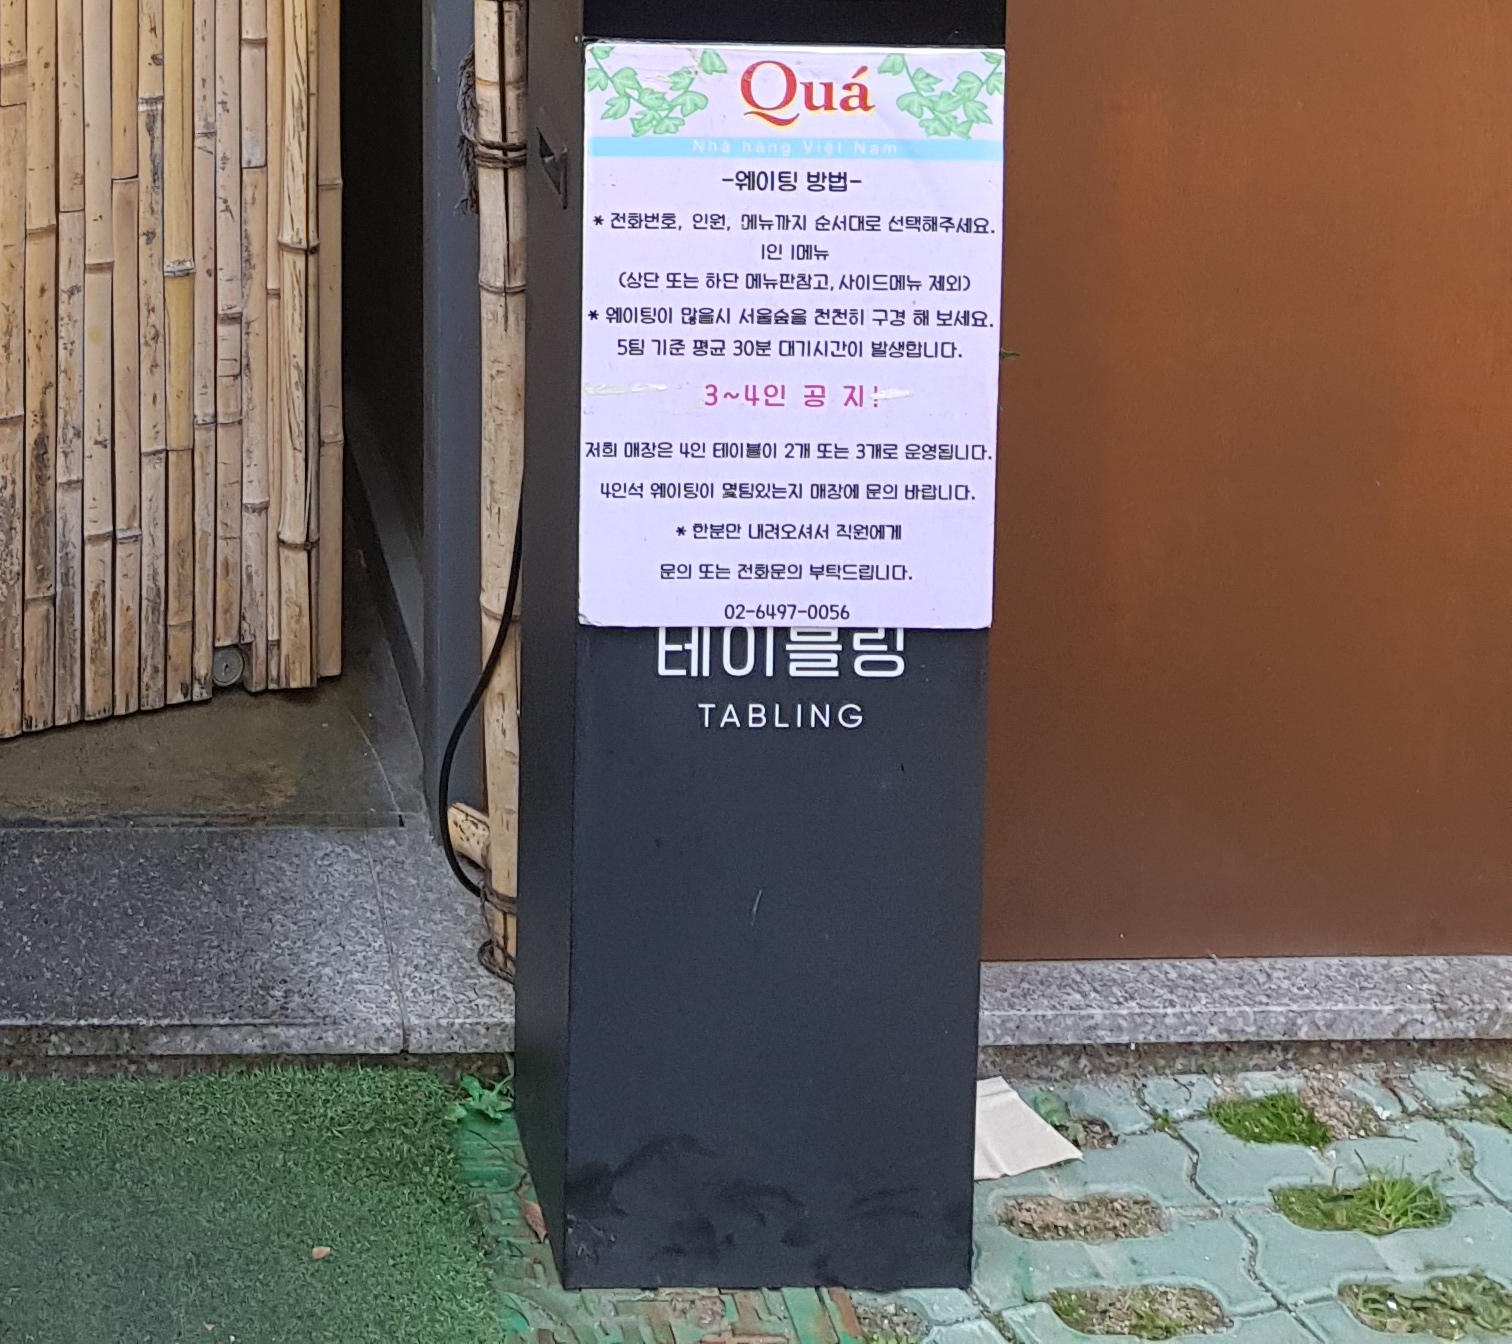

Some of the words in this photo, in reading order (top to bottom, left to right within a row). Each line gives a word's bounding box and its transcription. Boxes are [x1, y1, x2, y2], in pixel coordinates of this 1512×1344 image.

[740, 60, 876, 127] Quá
[722, 171, 797, 191] -웨이팅
[807, 172, 862, 192] 방법-
[611, 213, 681, 230] 전화번호,
[693, 213, 730, 231] 인원,
[741, 214, 806, 231] 메뉴까지
[816, 215, 881, 231] 순서대로
[889, 216, 995, 233] 선택해주세요.
[619, 272, 659, 288] (상단
[666, 273, 699, 288] 또는
[706, 273, 739, 289] 하단
[929, 275, 970, 291] 제외)
[606, 307, 672, 324] 웨이팅이
[681, 307, 730, 325] 많을시
[815, 309, 864, 325] 천천히
[872, 309, 905, 326] 구경
[937, 310, 993, 327] 보세요.
[618, 339, 644, 355] 5팀
[651, 339, 685, 356] 기준
[693, 339, 725, 356] 평균
[733, 340, 771, 356] 30분
[779, 340, 862, 357] 대기시간이
[872, 341, 962, 358] 발생합니다.
[585, 442, 617, 457] 저희
[624, 442, 673, 458] 매장은
[680, 442, 705, 458] 4인
[713, 442, 776, 458] 테이블이
[785, 443, 810, 458] 2개
[817, 443, 849, 459] 또는
[856, 444, 898, 459] 3개로
[905, 444, 991, 460] 운영됩니다.
[601, 483, 643, 498] 4인석
[651, 483, 714, 499] 웨이팅이
[811, 484, 859, 499] 매장에
[867, 484, 897, 499] 문의
[905, 484, 975, 500] 바랍니다.
[693, 523, 741, 539] 한분만
[749, 524, 828, 539] 내려오셔서
[837, 524, 901, 540] 직원에게
[661, 564, 691, 579] 문의
[699, 564, 730, 579] 또는
[738, 564, 802, 579] 전화문의
[810, 564, 912, 580] 부탁드립니다.
[725, 604, 850, 620] 02-6497-0056
[698, 703, 864, 728] TABLING
